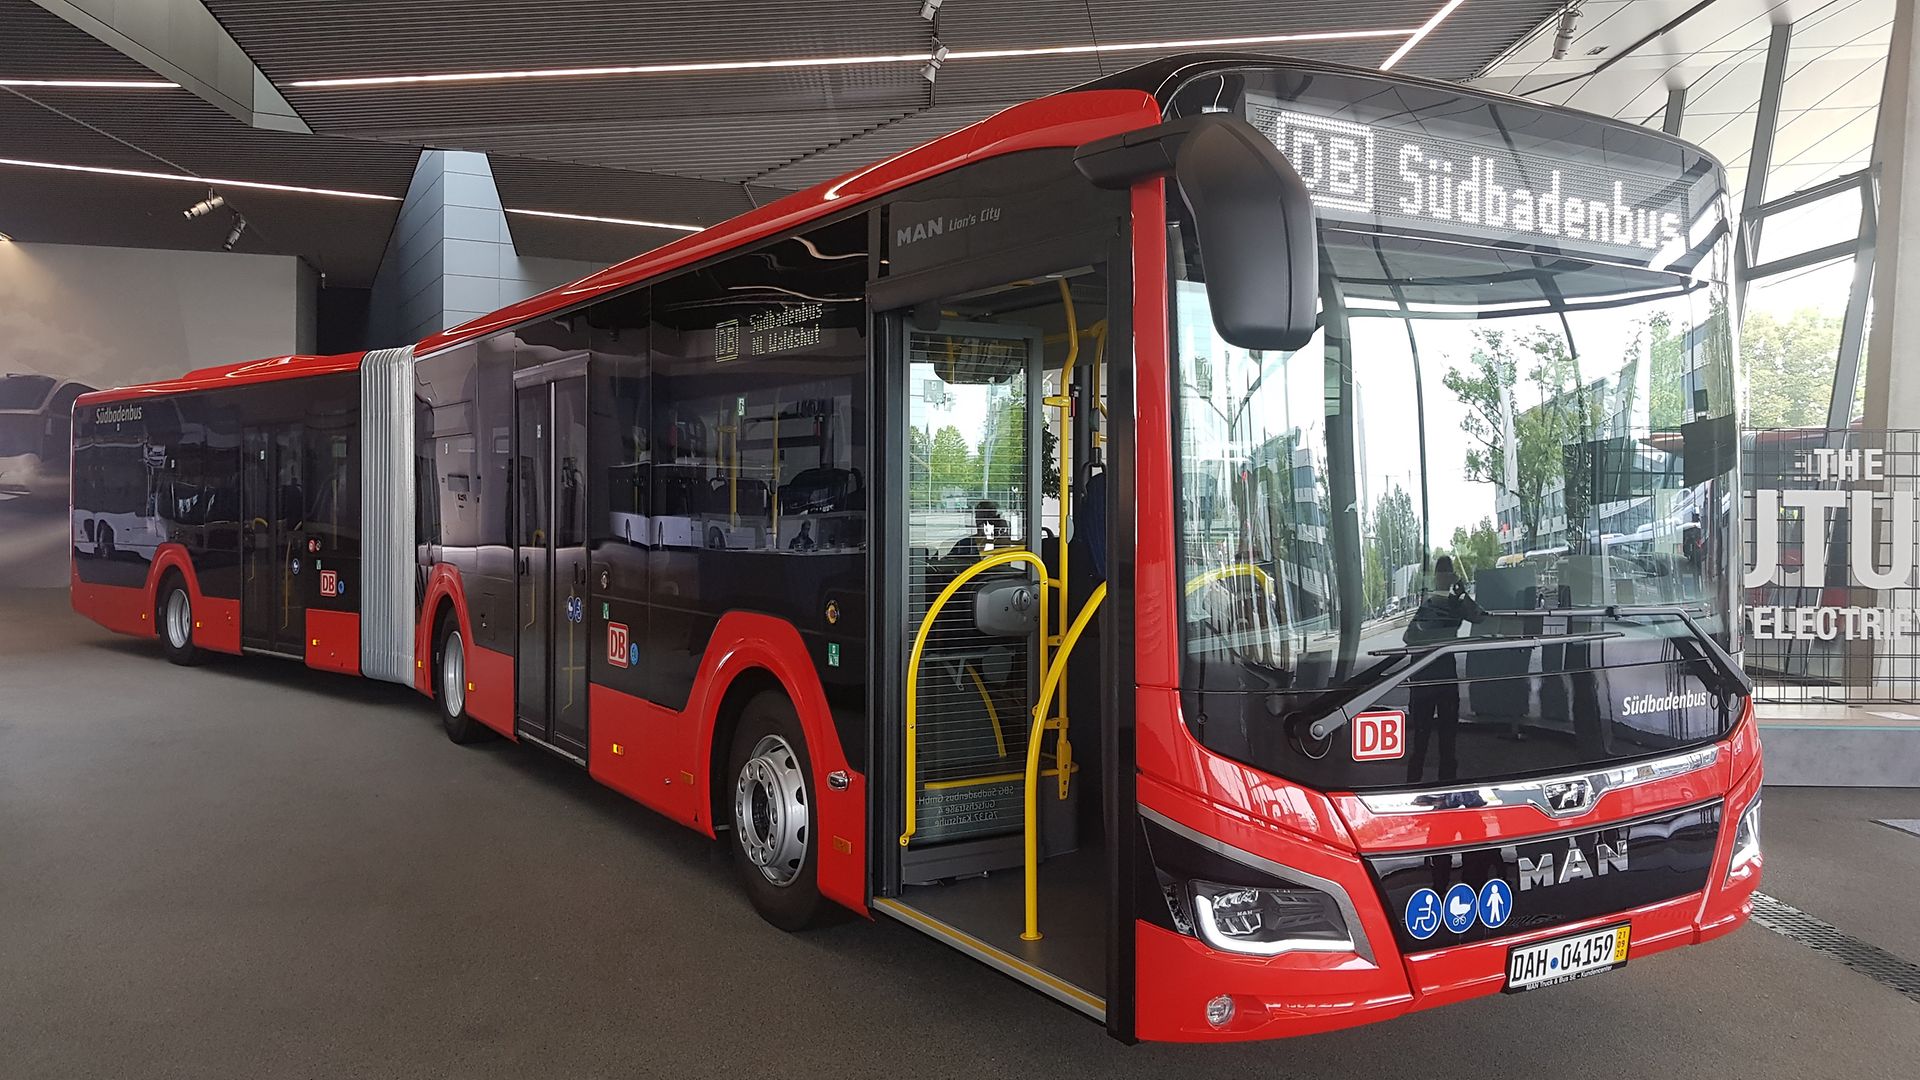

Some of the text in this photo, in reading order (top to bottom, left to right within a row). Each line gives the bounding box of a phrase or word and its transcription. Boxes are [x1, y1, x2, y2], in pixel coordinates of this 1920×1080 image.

[1400, 144, 1682, 249] Südbadenbus
[897, 207, 1001, 247] MAN Lion's City
[749, 302, 823, 334] Südbadenbus
[752, 323, 820, 356] NL Waldshut
[95, 404, 142, 425] Südbadenbus
[1814, 448, 1883, 481] THE
[1753, 606, 1920, 641] ELECTRIF
[610, 629, 626, 659] DB
[1622, 689, 1707, 716] Südbadenbus
[1360, 719, 1399, 752] DB
[1518, 839, 1629, 892] MAN
[1618, 930, 1626, 939] 21
[1511, 934, 1614, 983] DAH 04159
[1526, 982, 1539, 991] MAN
[1540, 979, 1554, 987] Truck
